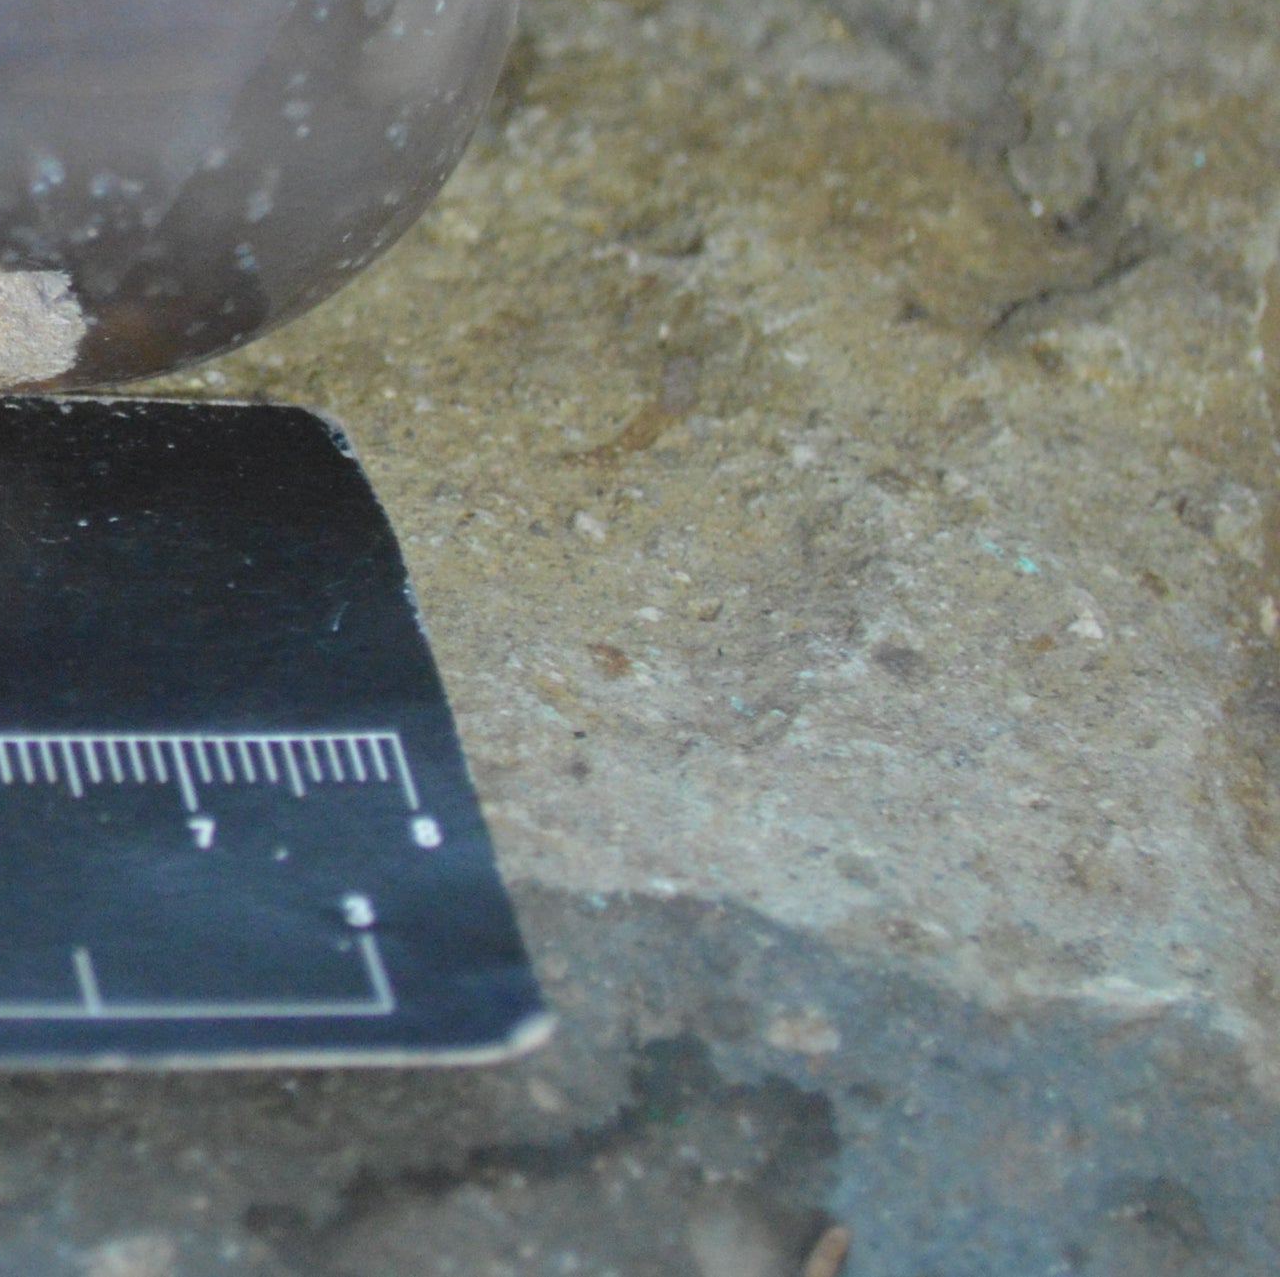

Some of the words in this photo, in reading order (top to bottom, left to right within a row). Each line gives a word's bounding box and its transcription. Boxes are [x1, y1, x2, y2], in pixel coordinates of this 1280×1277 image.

[188, 817, 215, 849] 7
[411, 817, 442, 848] 8
[342, 894, 374, 927] 3
